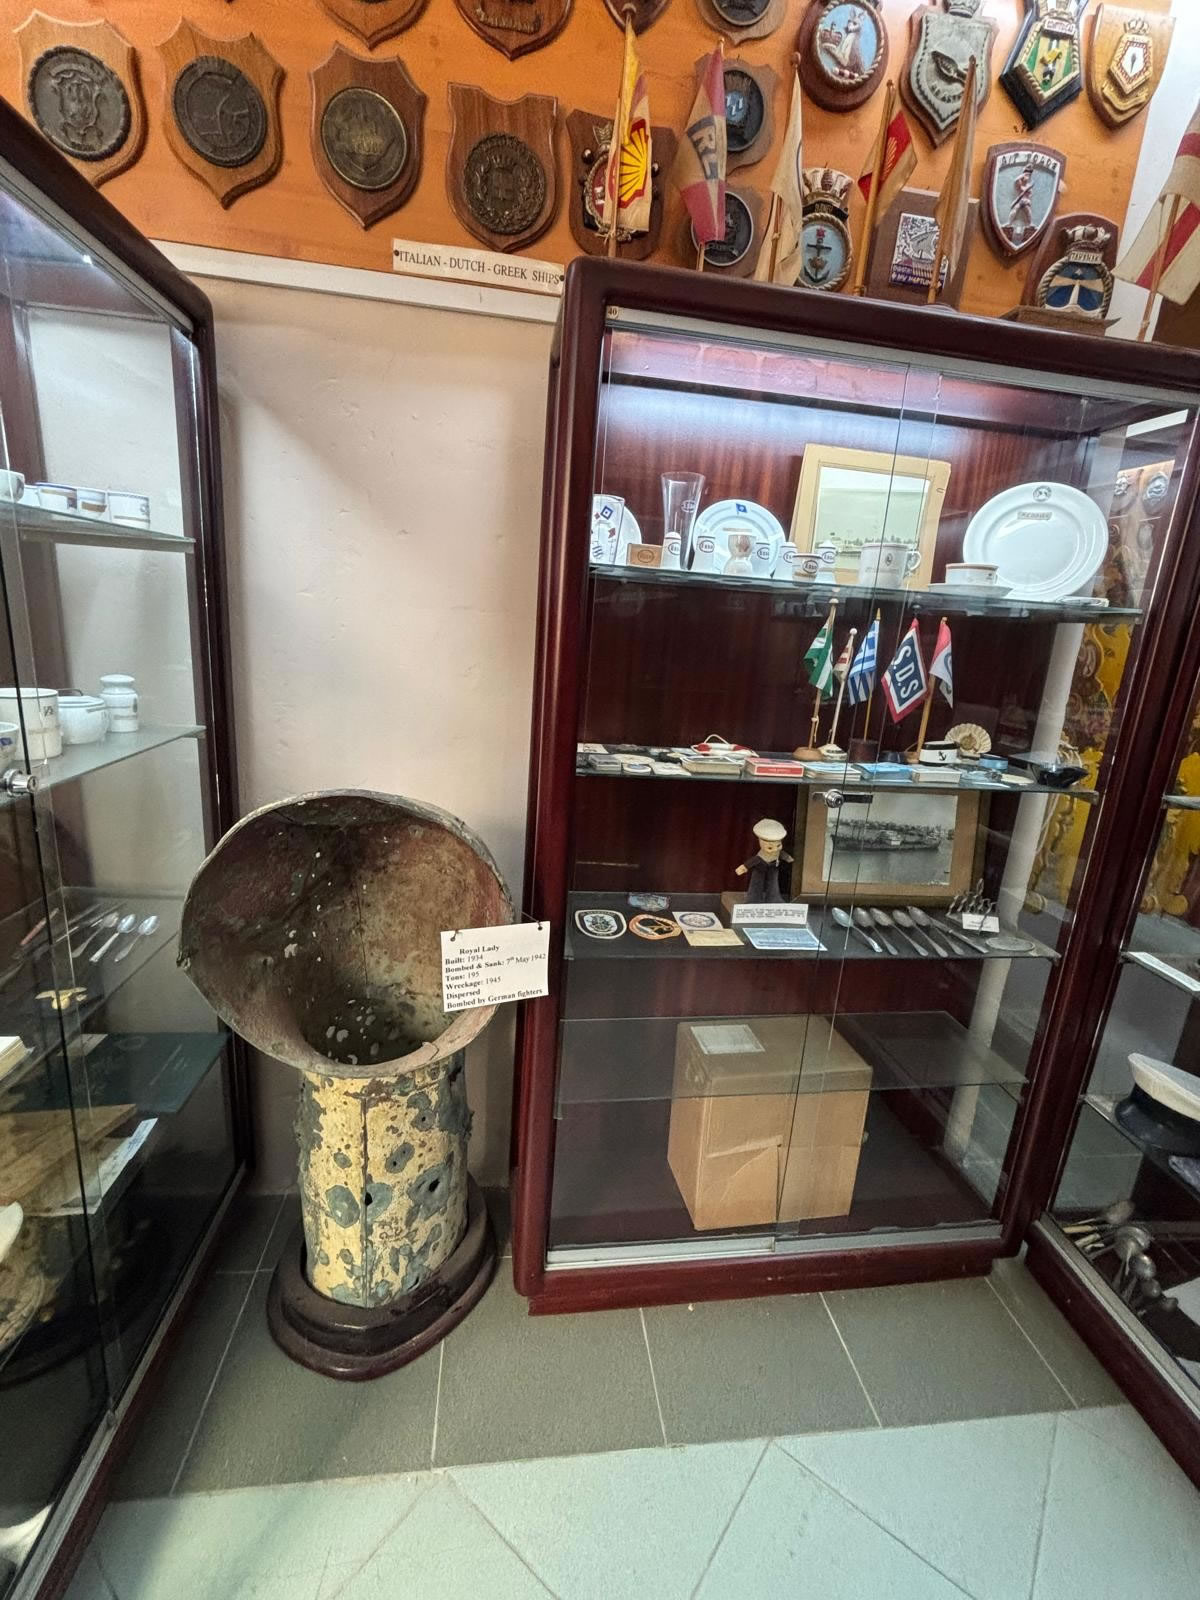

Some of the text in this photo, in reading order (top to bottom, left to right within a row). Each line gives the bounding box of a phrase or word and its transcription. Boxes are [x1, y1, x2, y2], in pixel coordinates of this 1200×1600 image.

[399, 250, 441, 267] ITALIAN
[449, 257, 486, 273] DUTCH
[493, 264, 528, 280] GREEK
[531, 270, 560, 285] SHIPS
[459, 944, 500, 955] Royal Lady
[445, 954, 484, 966] Built: 1934
[445, 963, 475, 974] Bombed
[484, 960, 504, 969] Sank:
[515, 956, 530, 965] May
[531, 953, 546, 962] 1942
[445, 971, 480, 982] Tons: 195
[446, 976, 502, 990] Wreckage: 1945
[446, 988, 481, 1000] Dispersed
[447, 989, 543, 1009] Bombed by German fighters
